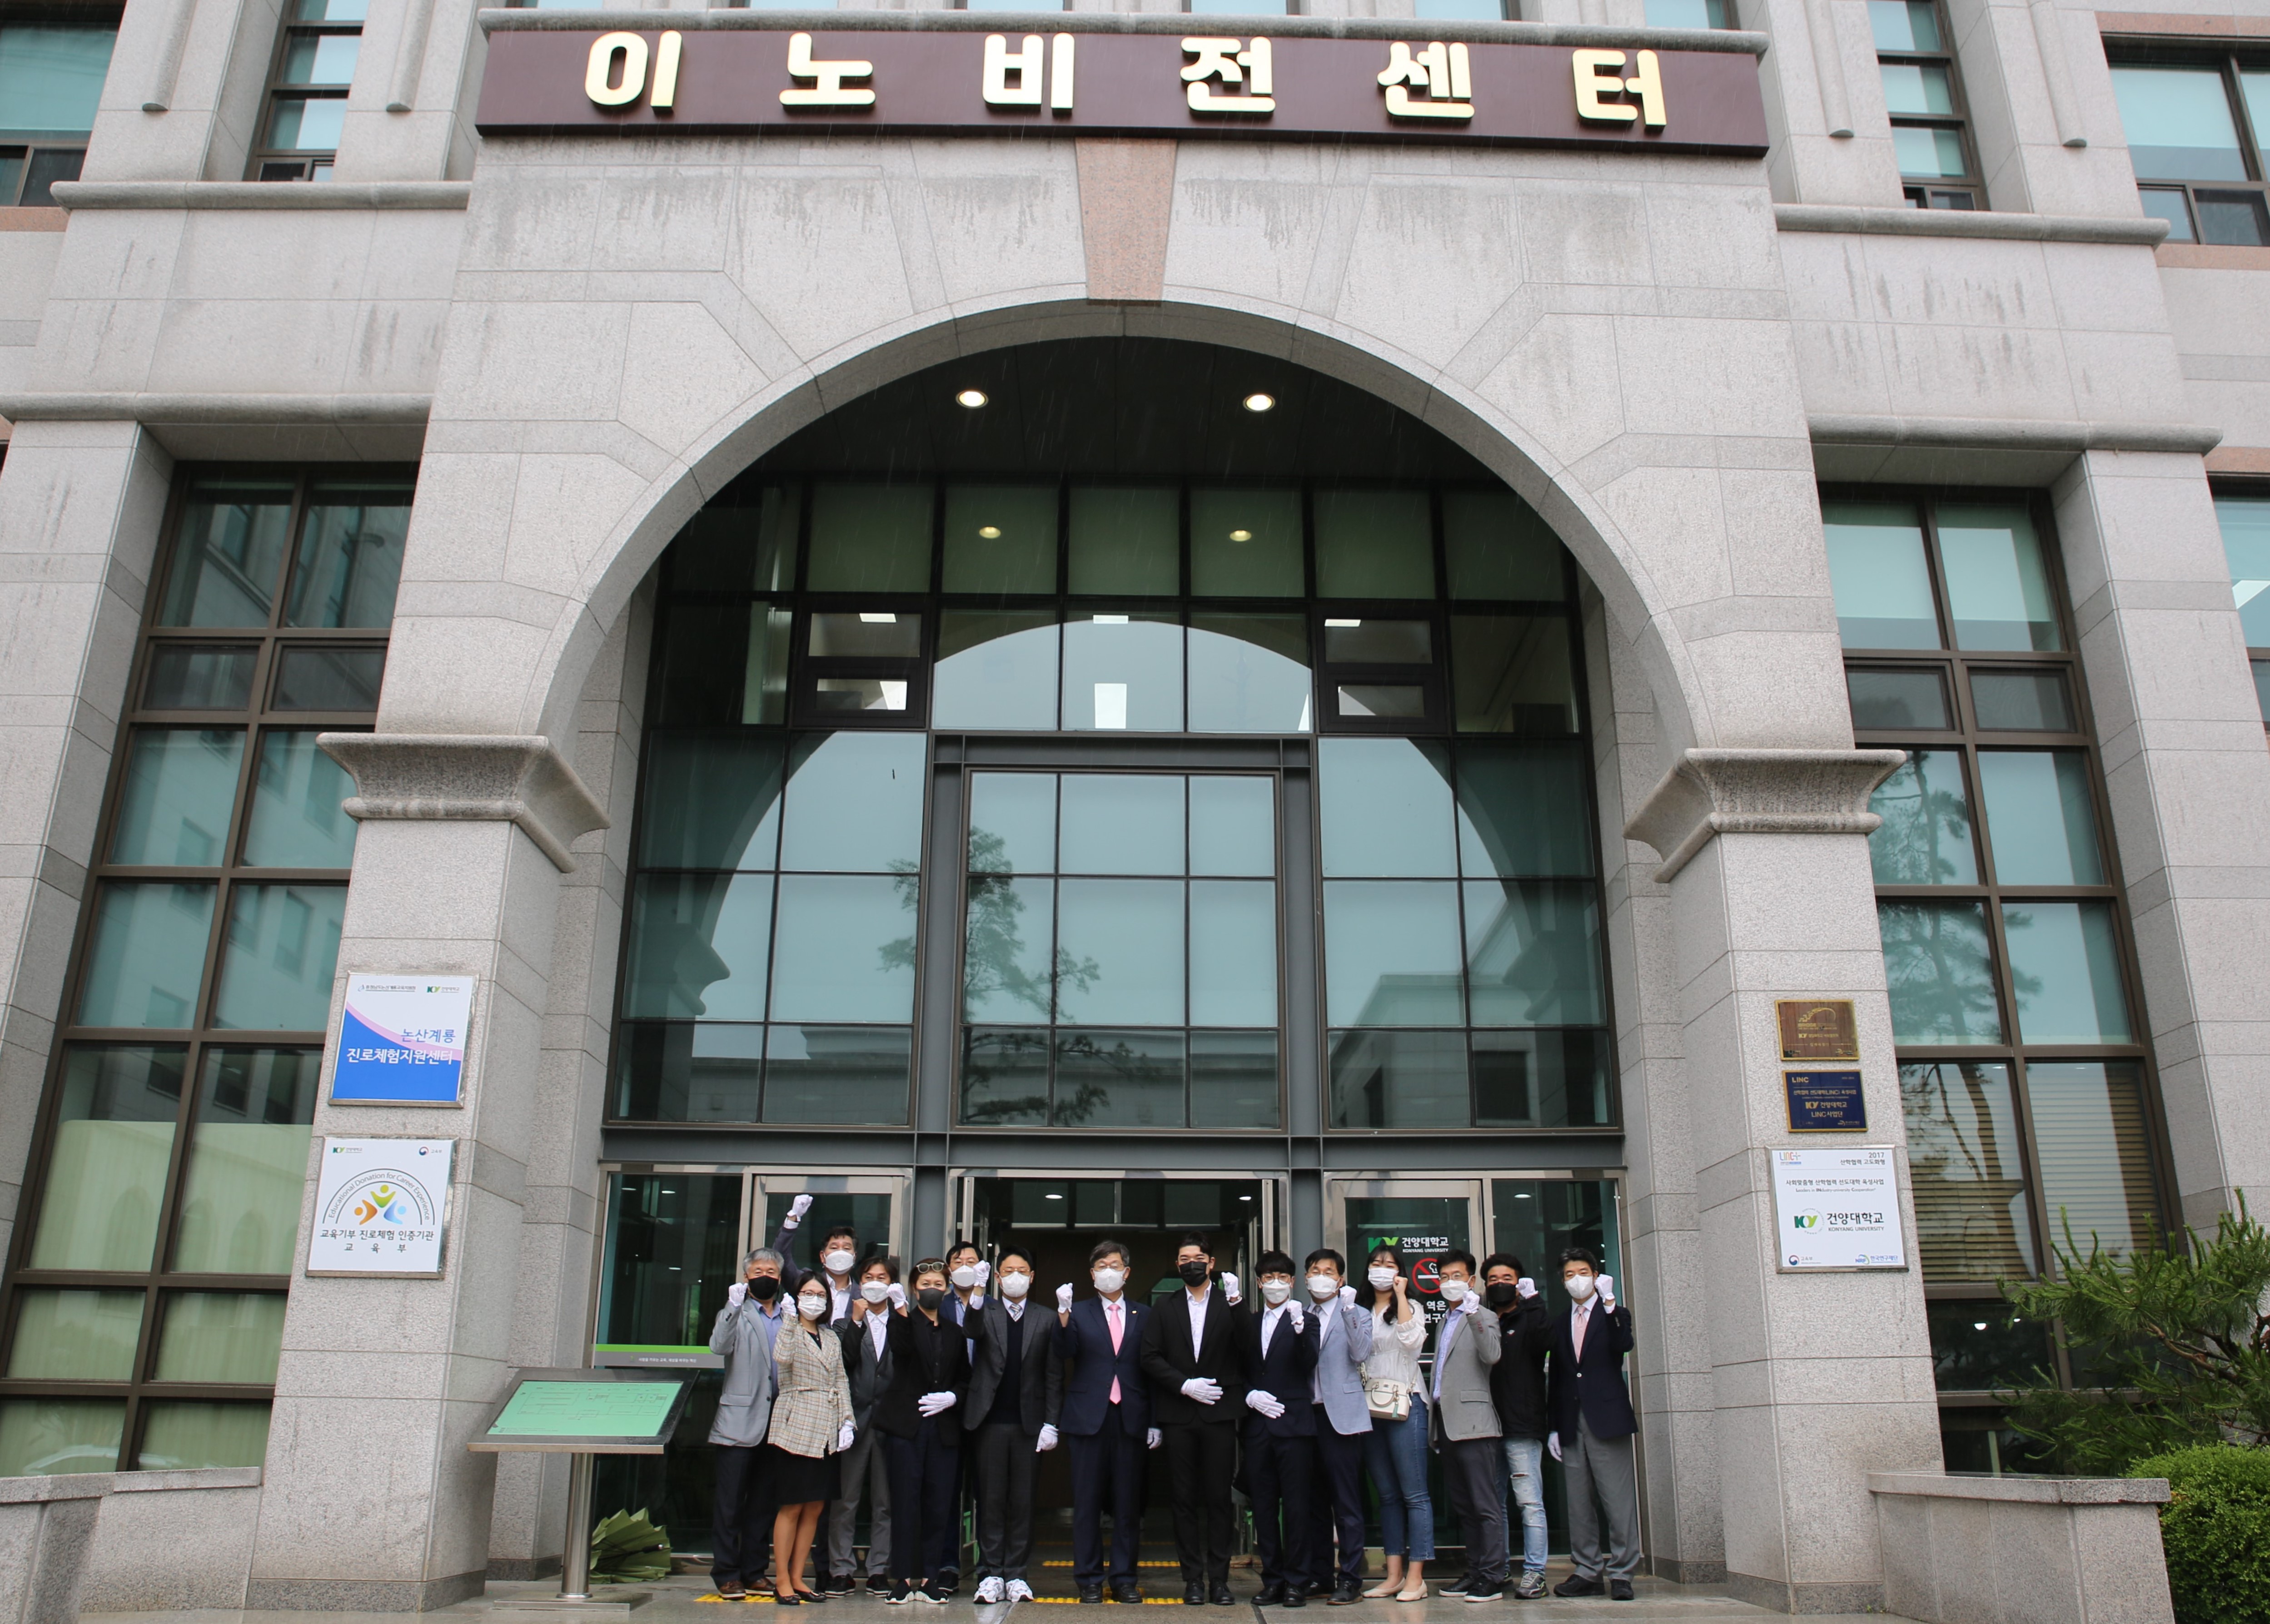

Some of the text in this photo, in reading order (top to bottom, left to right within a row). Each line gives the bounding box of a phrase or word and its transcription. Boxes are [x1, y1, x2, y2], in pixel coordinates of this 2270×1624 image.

[585, 30, 1668, 126] 이노비전센터
[401, 1029, 456, 1043] 논산계룡
[347, 1048, 453, 1065] 진로체험지원센터
[329, 1172, 430, 1221] Educational Donation for Career Experience
[1827, 1212, 1884, 1225] 건양대학교
[320, 1230, 434, 1241] 교육기부 진로체험 인증기관
[1402, 1237, 1449, 1248] 건양대학교
